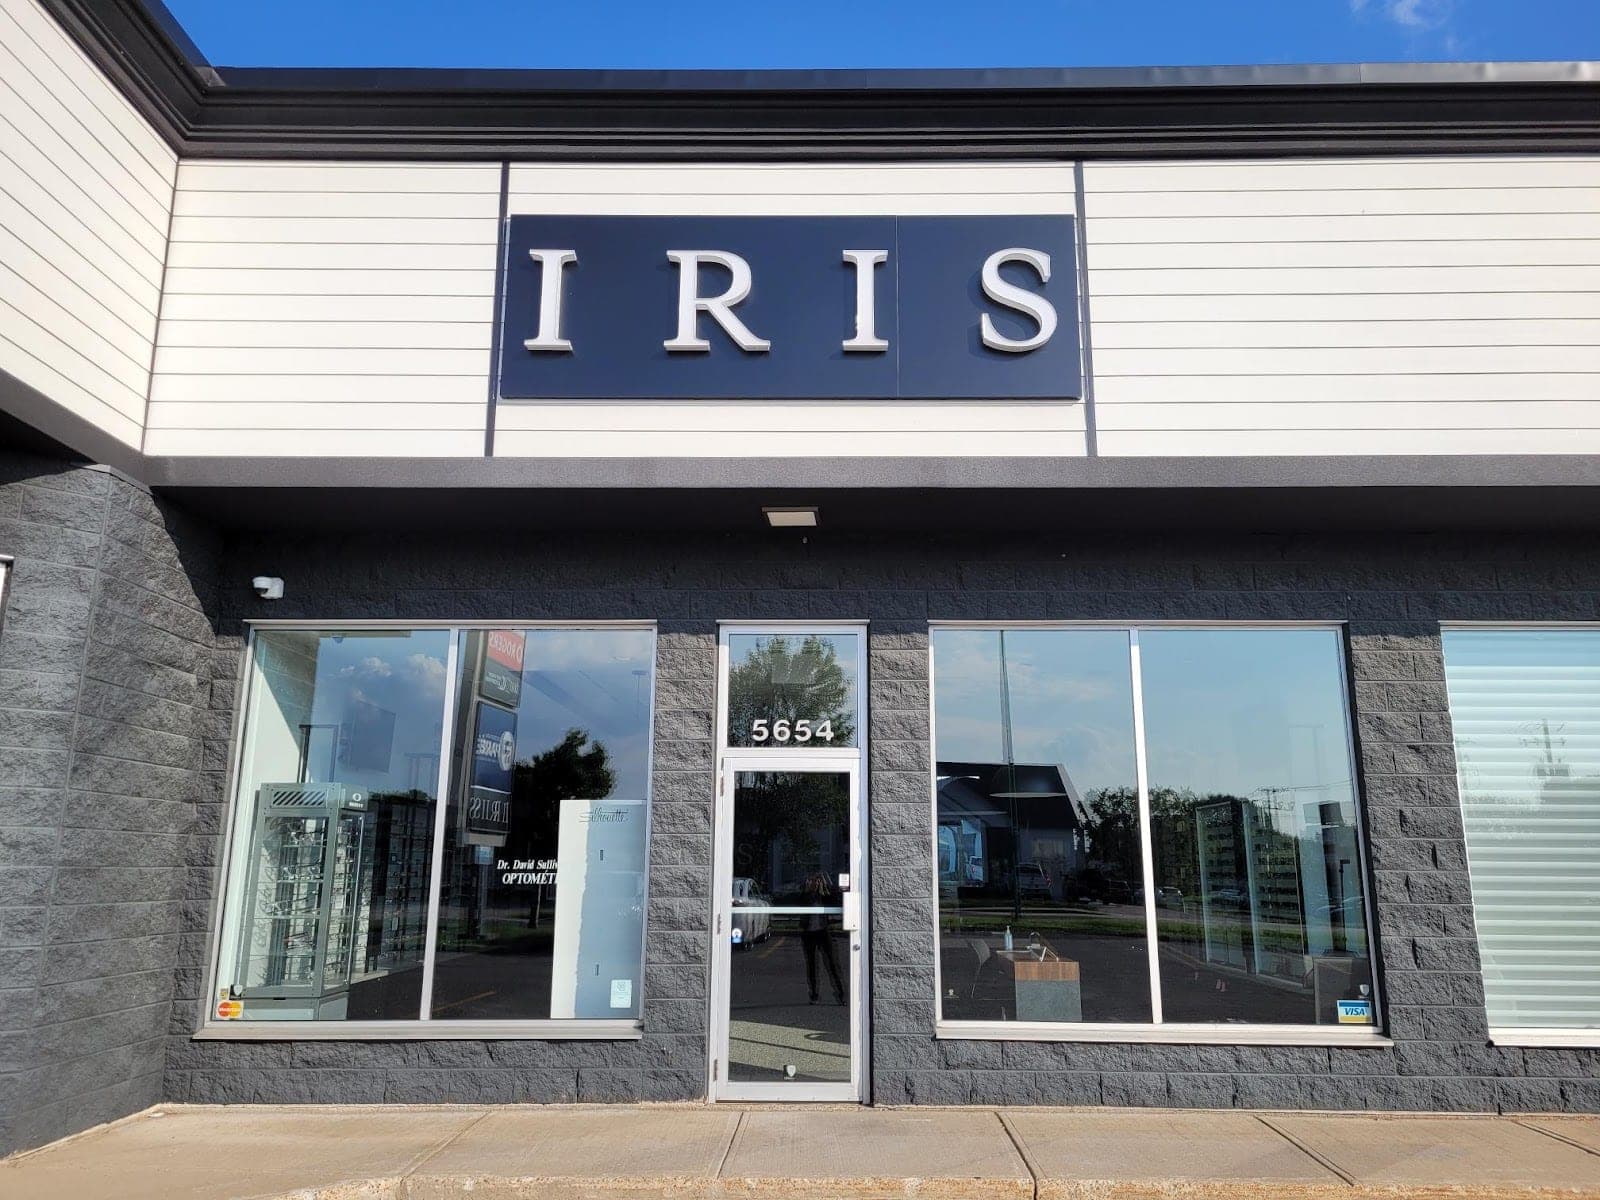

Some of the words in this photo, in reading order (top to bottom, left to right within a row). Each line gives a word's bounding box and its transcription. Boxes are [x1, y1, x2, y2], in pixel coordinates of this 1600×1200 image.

[524, 248, 1057, 352] IRIS
[752, 719, 834, 741] 5654
[496, 859, 510, 870] Dr.
[512, 859, 535, 870] David
[1344, 1007, 1365, 1016] VISA
